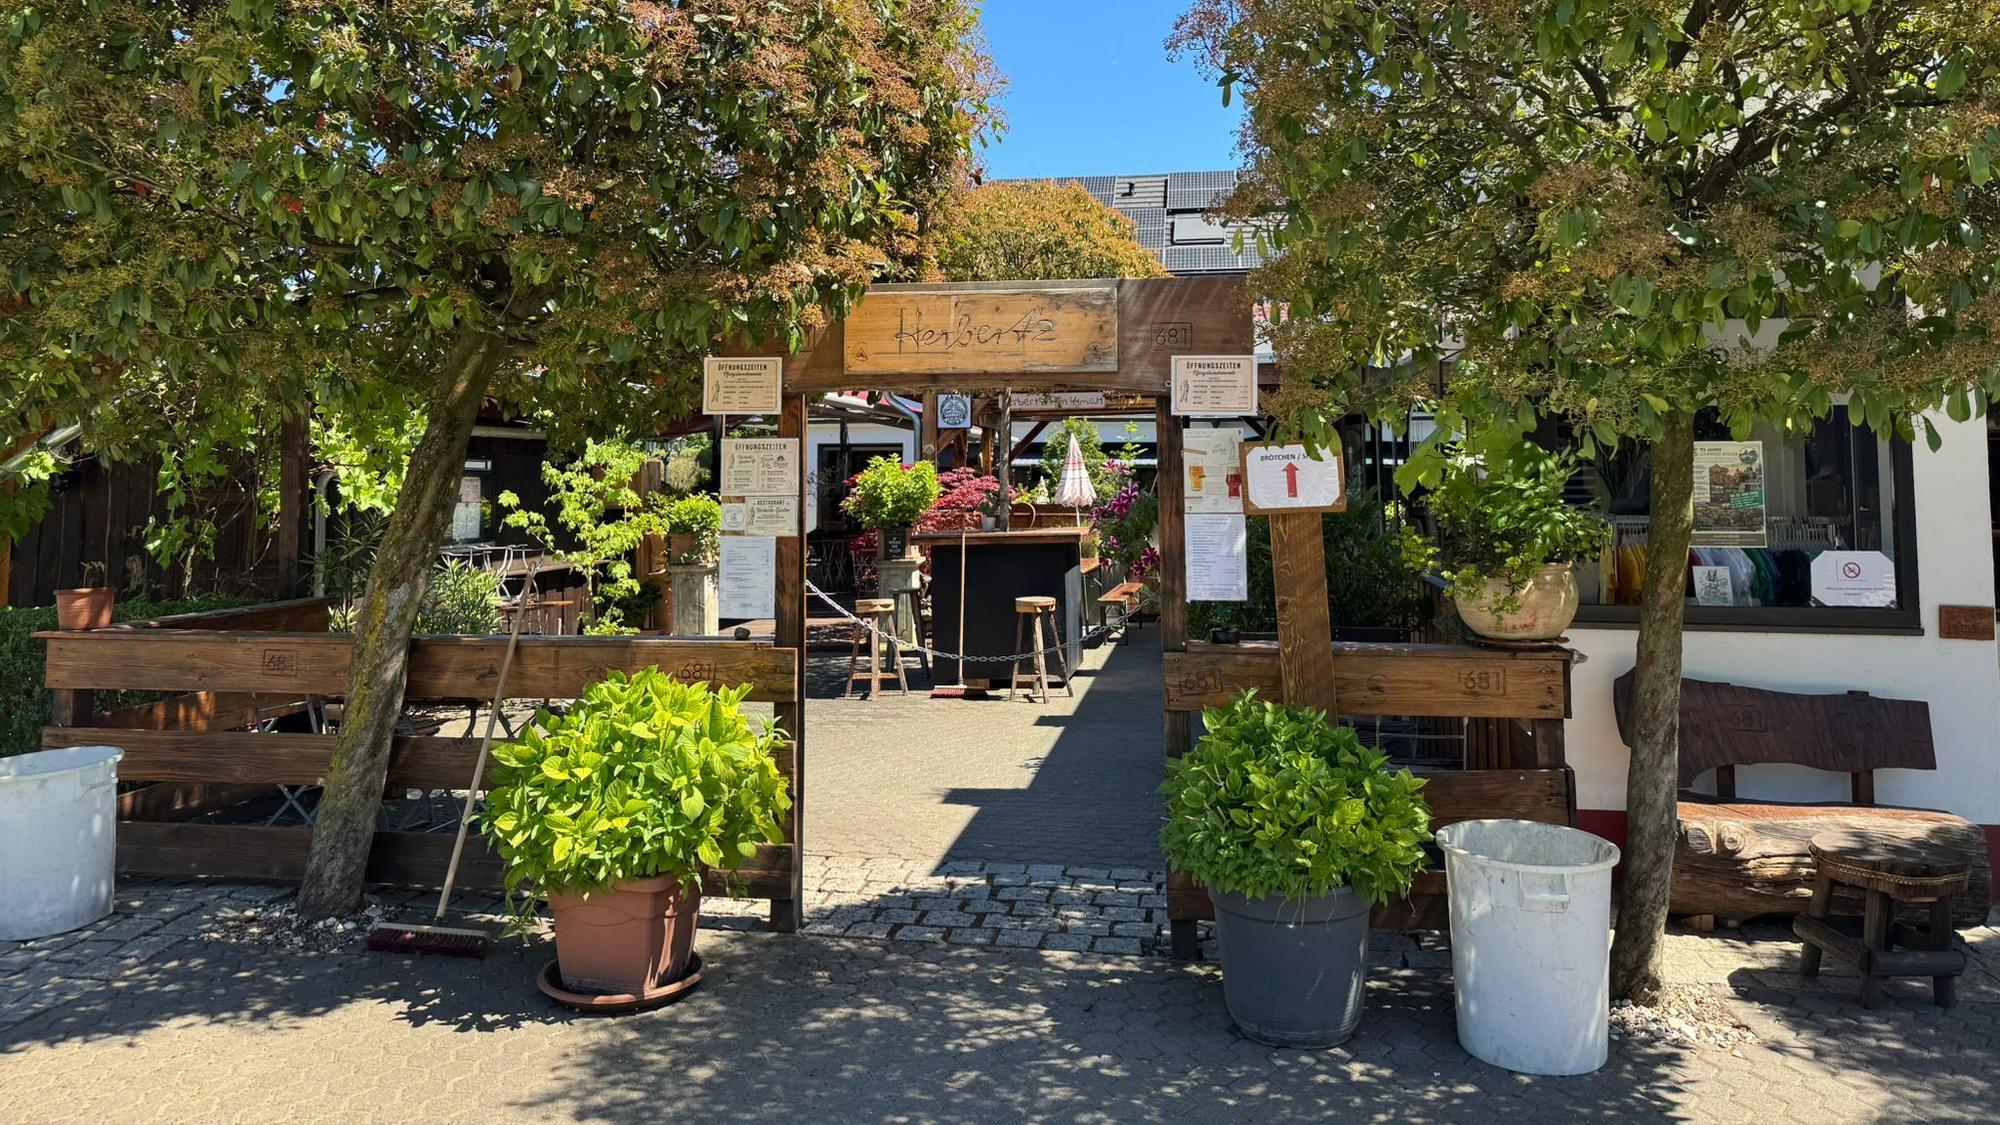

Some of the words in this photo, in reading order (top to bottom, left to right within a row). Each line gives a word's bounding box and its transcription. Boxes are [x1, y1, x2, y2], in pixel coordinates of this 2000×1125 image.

[895, 305, 1055, 354] Herbertz
[1156, 327, 1188, 346] 681
[717, 363, 767, 371] ÖFFNUNGSZEITEN
[1186, 361, 1241, 370] ÖFFNUNGSZEITEN
[735, 443, 787, 451] ÖFFNUNGSZEITEN
[1260, 454, 1296, 462] BRÖTCHEN
[681, 662, 711, 681] 681
[1184, 670, 1218, 690] 681
[1464, 670, 1500, 691] 681
[1730, 711, 1764, 729] 681
